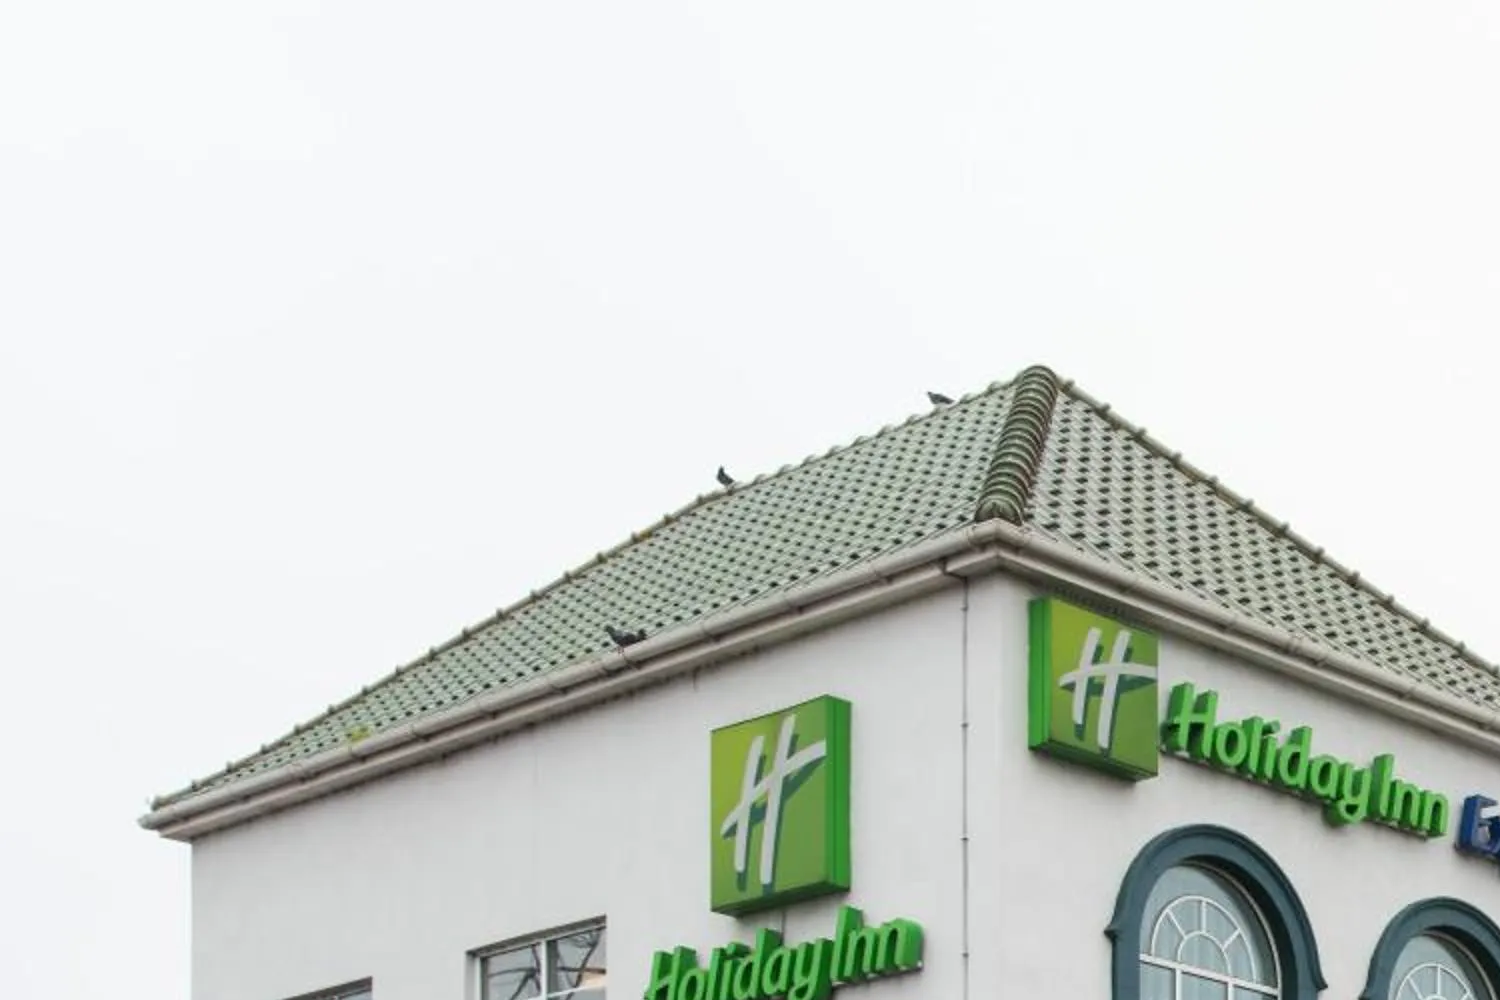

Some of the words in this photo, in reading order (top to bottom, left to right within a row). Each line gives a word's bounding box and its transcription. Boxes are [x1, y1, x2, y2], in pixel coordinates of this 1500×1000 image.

[1163, 682, 1371, 827] Holiday
[1370, 753, 1449, 839] Inn
[830, 904, 924, 983] Inn
